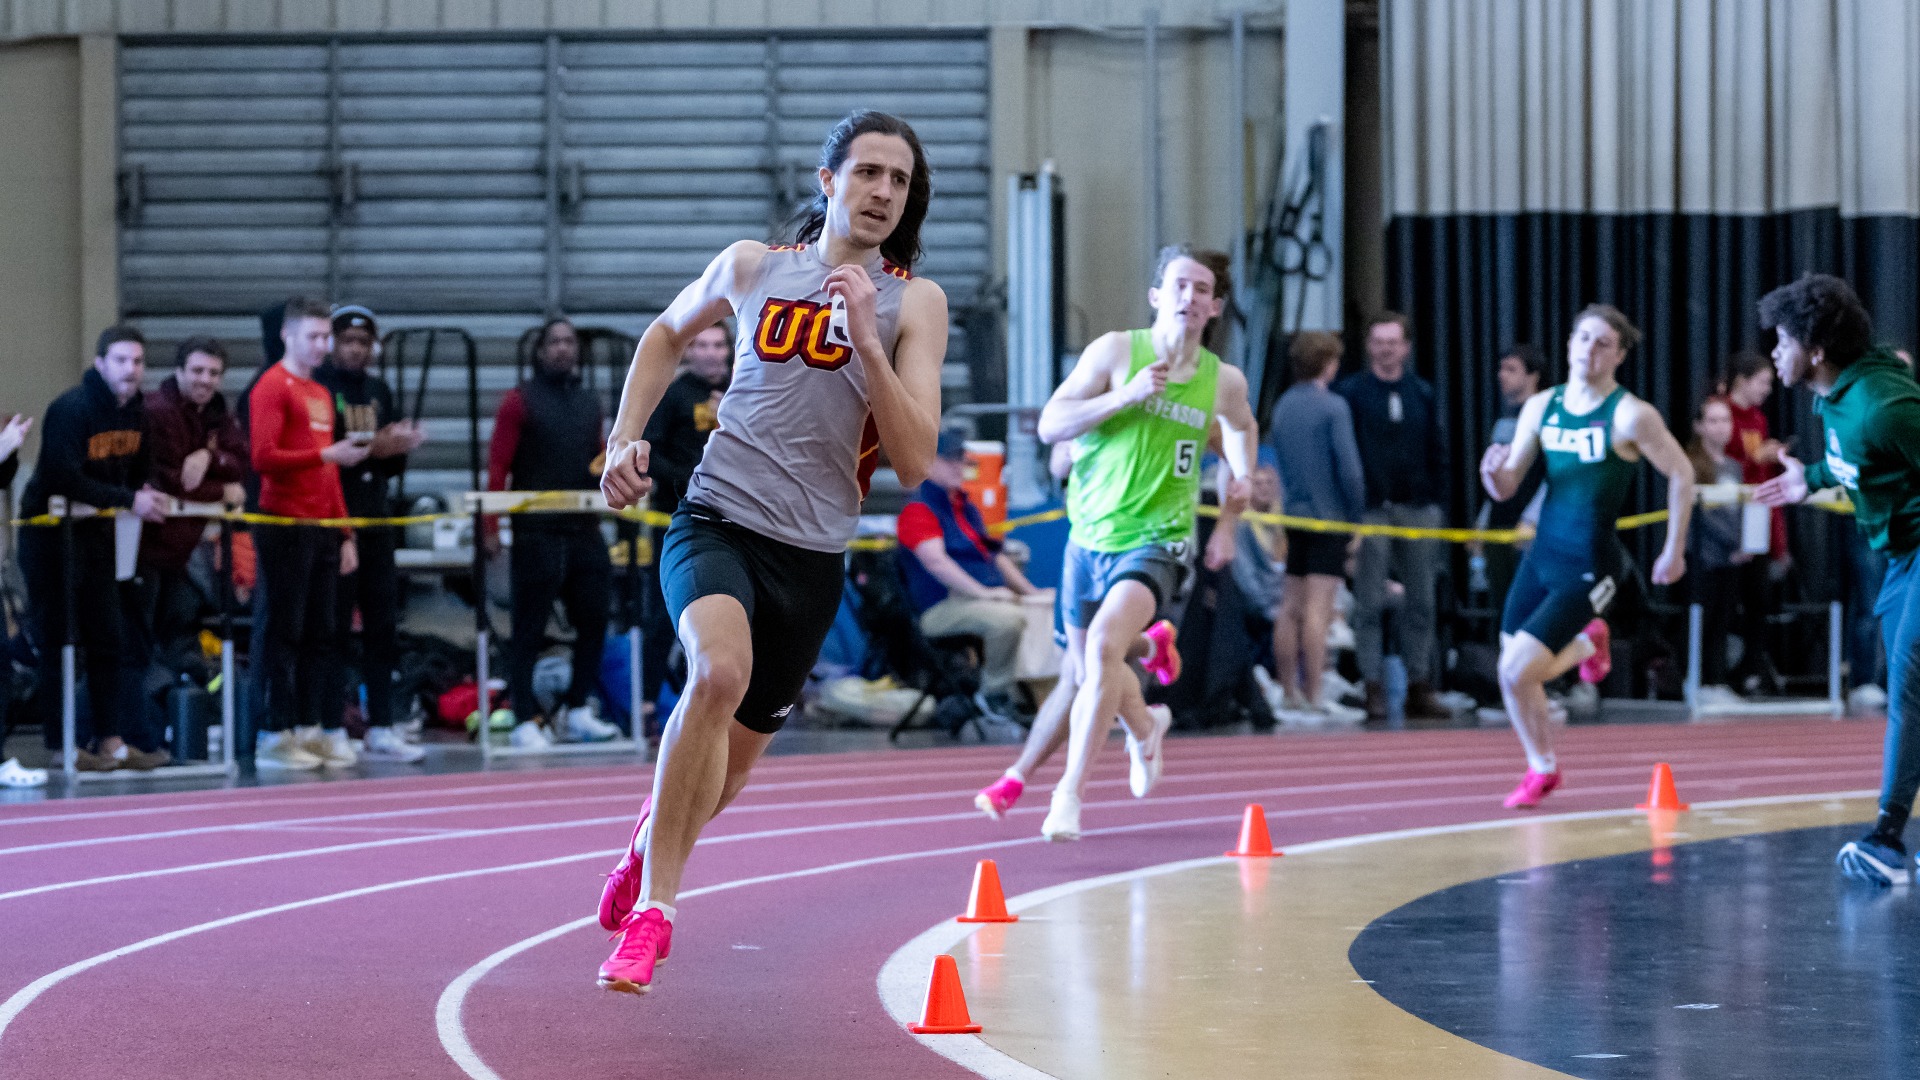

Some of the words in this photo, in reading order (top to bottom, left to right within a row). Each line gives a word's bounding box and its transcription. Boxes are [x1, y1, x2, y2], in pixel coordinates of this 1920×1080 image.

[754, 297, 853, 371] UC
[1144, 396, 1206, 430] EVENSON
[1179, 444, 1192, 473] 5
